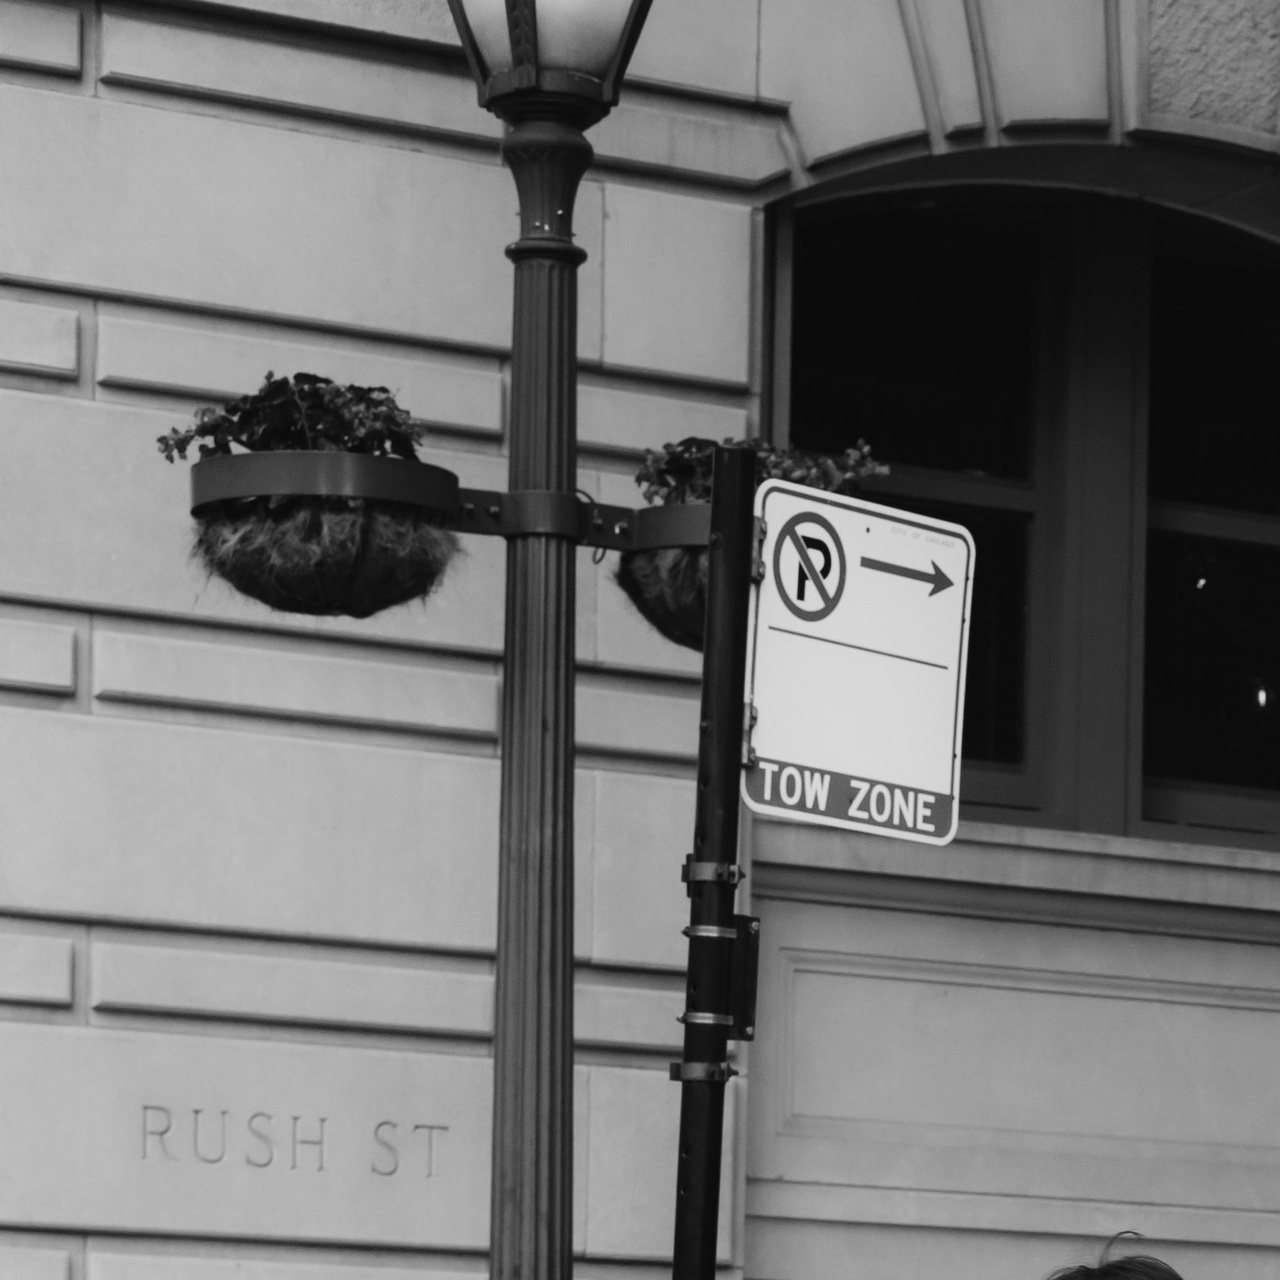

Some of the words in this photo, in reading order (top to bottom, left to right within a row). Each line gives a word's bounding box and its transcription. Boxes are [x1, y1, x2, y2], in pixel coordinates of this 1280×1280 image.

[758, 761, 831, 812] TOW
[847, 779, 936, 833] ZONE
[141, 1104, 328, 1172] RUSH
[370, 1120, 449, 1179] ST
